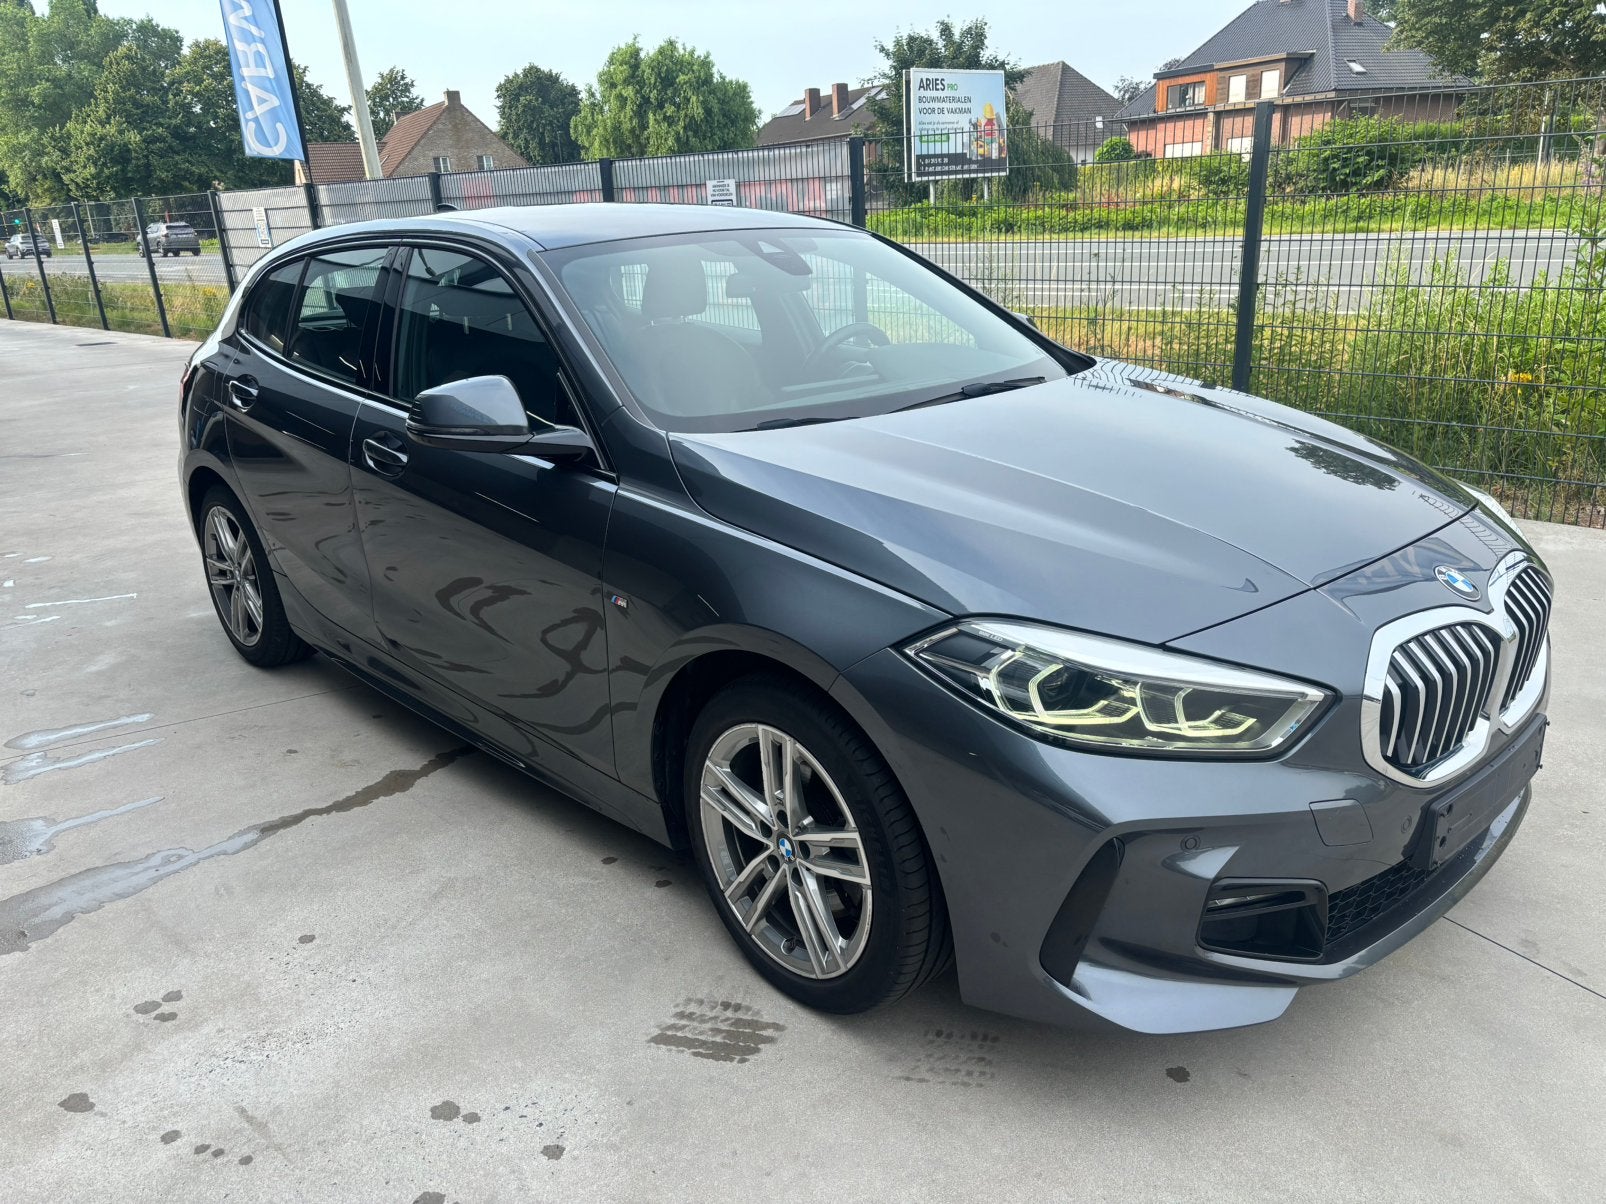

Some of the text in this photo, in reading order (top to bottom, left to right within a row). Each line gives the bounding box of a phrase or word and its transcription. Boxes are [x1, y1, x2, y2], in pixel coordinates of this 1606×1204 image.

[918, 77, 959, 92] ARIES PRO
[918, 95, 972, 104] BOUWMATERIALEN
[918, 107, 972, 115] VOOR DE VAKMAN
